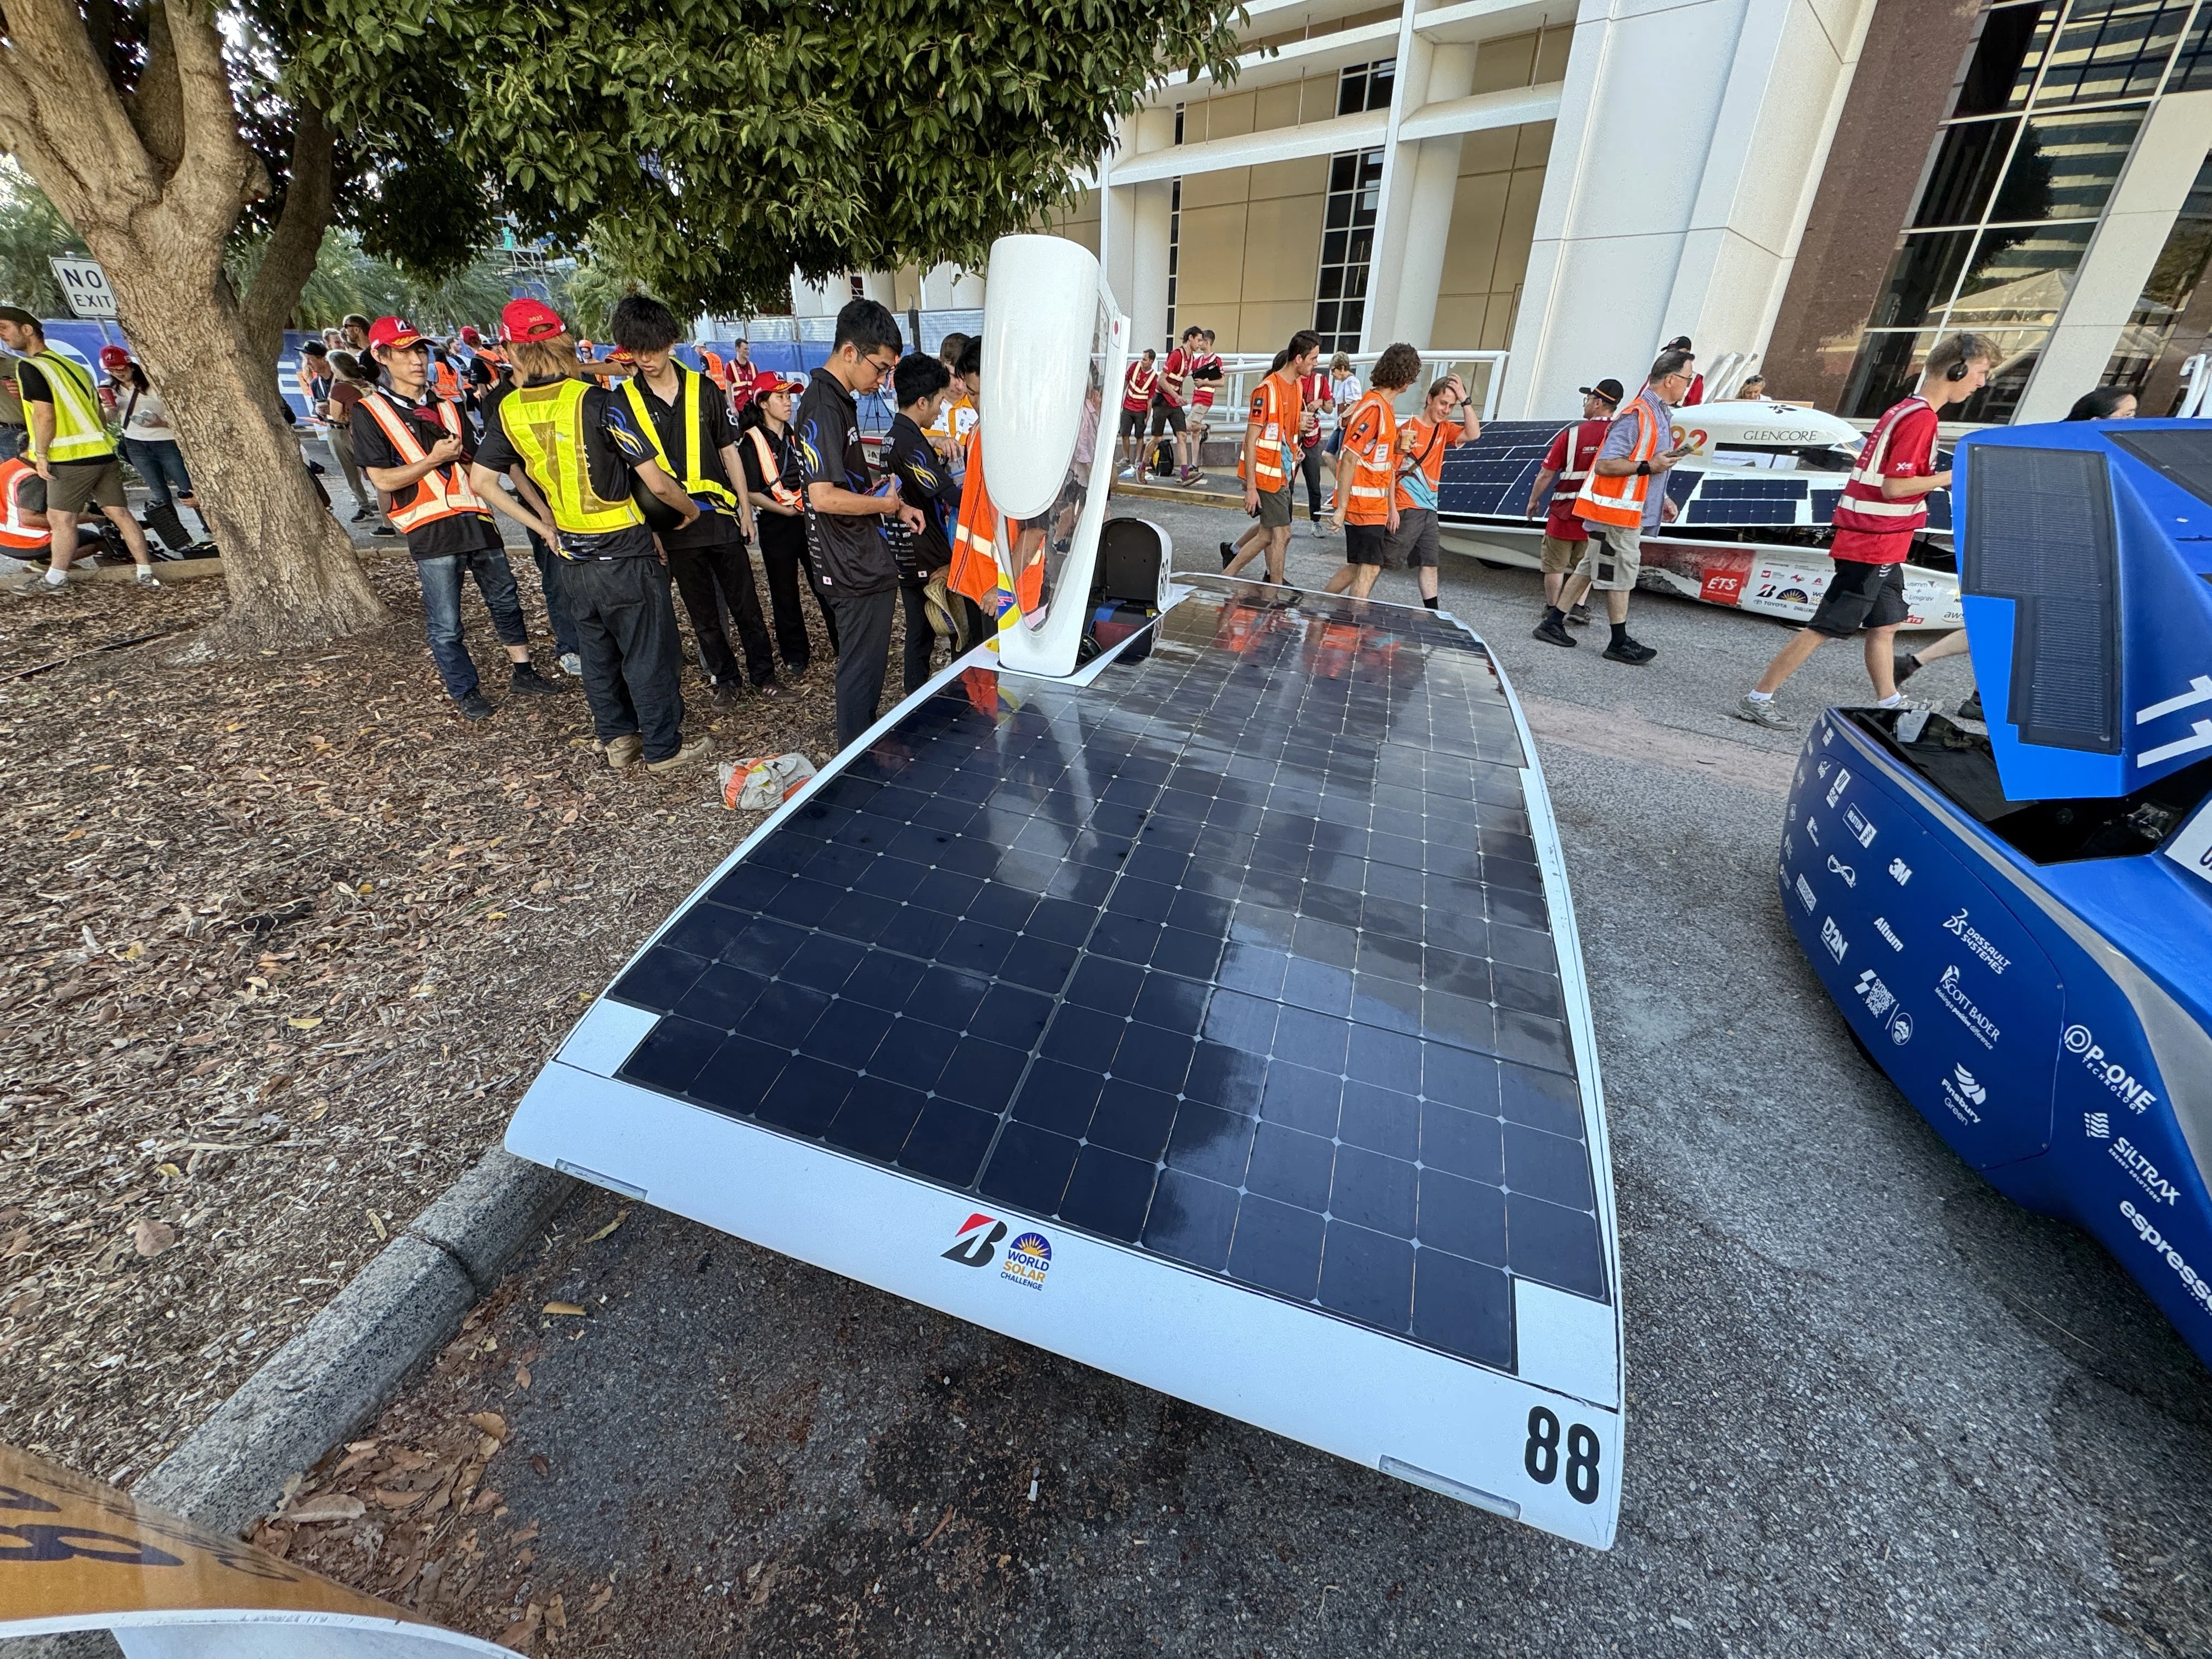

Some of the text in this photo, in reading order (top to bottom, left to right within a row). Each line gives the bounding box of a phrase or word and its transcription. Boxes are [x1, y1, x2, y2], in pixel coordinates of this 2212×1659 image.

[63, 268, 102, 288] NO
[73, 294, 111, 307] EXIT
[1671, 426, 1708, 456] 92
[1743, 431, 1818, 441] GLENCORE
[1707, 576, 1738, 590] ÉTS
[1889, 858, 1912, 886] 3M
[1821, 916, 1848, 961] D2N
[1874, 917, 1904, 952] Altium
[1966, 927, 2011, 967] DASSAULT
[1961, 934, 2004, 974] SYSTEMES
[1868, 991, 1887, 1014] SPORT
[1871, 985, 1889, 1009] MOTOR
[1875, 978, 1896, 1005] SYDNEY
[1865, 998, 1878, 1018] PARK
[1934, 987, 1951, 1007] Making
[1951, 1007, 1972, 1027] positive
[1970, 1025, 1993, 1050] difference
[1942, 979, 2000, 1042] SCOTT BADER
[2082, 1057, 2143, 1115] TECHNOLOGY
[2085, 1045, 2157, 1111] P-ONE
[1942, 1079, 1981, 1123] Finsbury
[1944, 1097, 1968, 1126] Green
[2108, 1148, 2162, 1203] ENERGY SOLUTIONS
[1003, 1261, 1046, 1283] SOLAR
[1008, 1249, 1049, 1272] WORLD
[1000, 1271, 1043, 1291] CHALLENGE
[1525, 1406, 1600, 1504] 88
